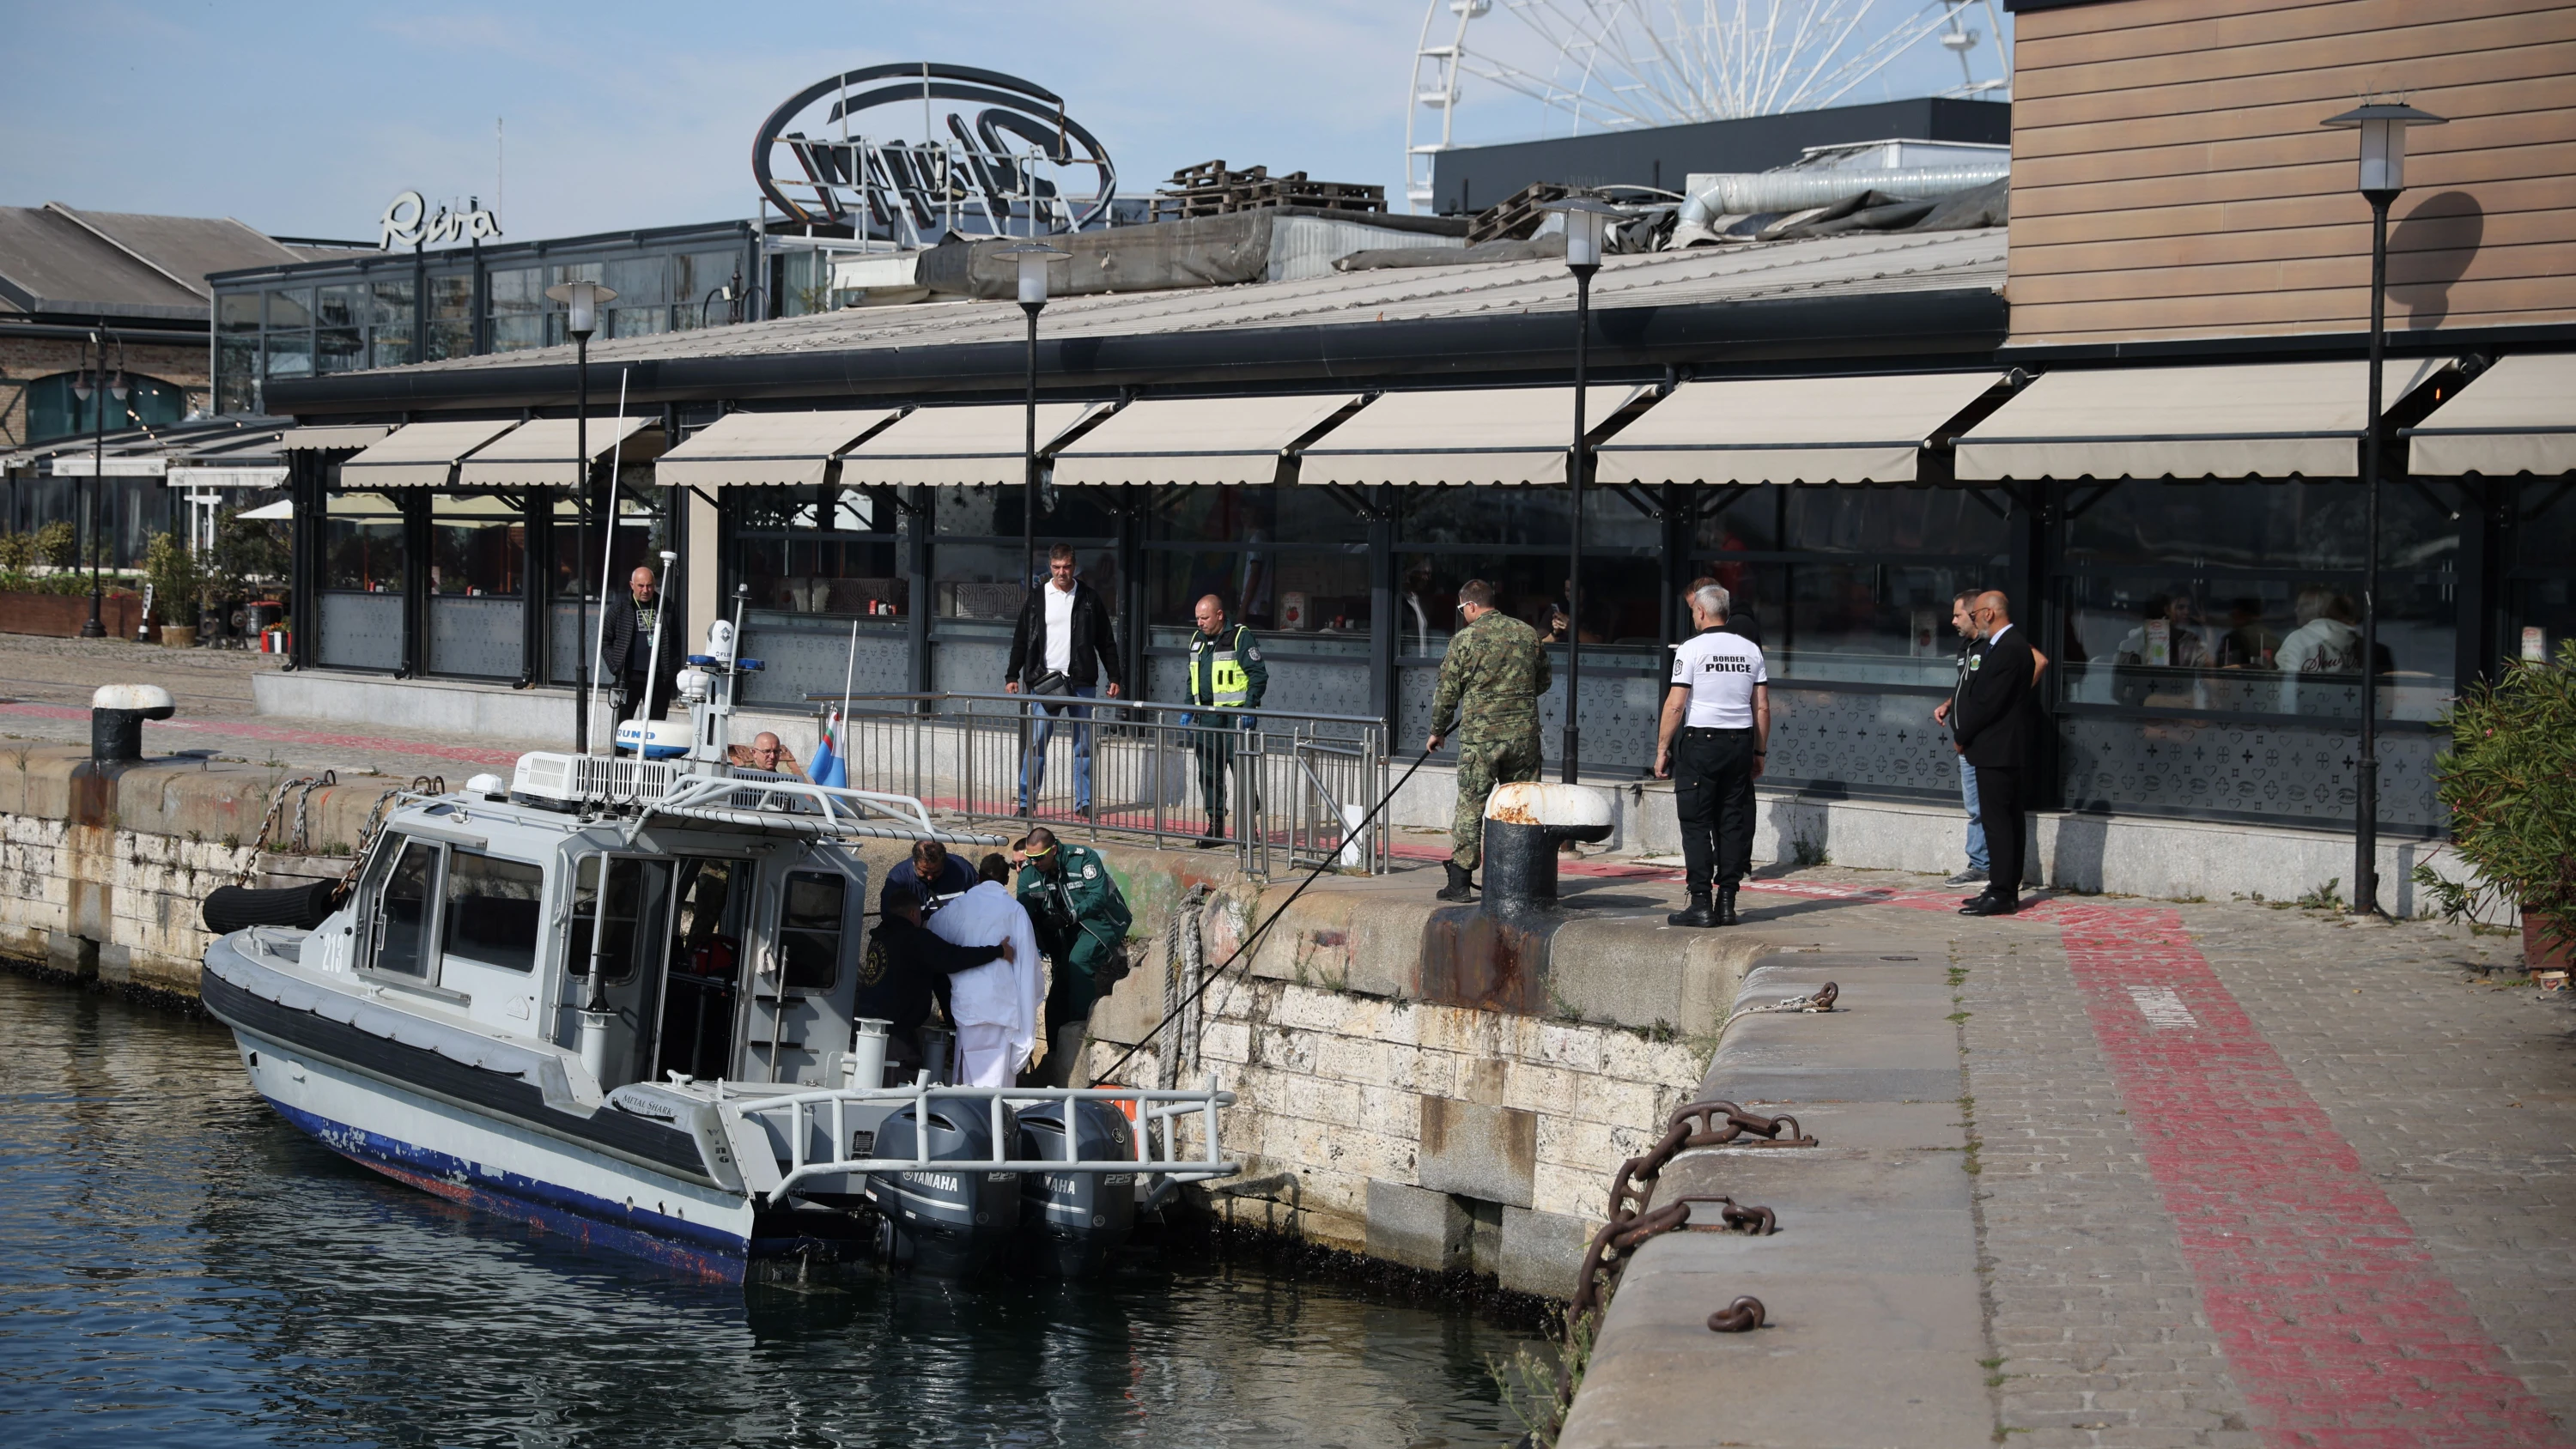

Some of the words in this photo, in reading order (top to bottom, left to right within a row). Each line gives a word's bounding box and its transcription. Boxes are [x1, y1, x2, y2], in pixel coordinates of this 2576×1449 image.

[379, 190, 503, 252] Riva
[1705, 664, 1752, 673] POLICE
[322, 931, 344, 974] 213
[622, 1094, 646, 1108] METAL
[647, 1100, 674, 1116] SHARK
[913, 1172, 958, 1192] YAMAHA
[1030, 1172, 1076, 1195] YAMAHA
[1104, 1173, 1133, 1186] 225
